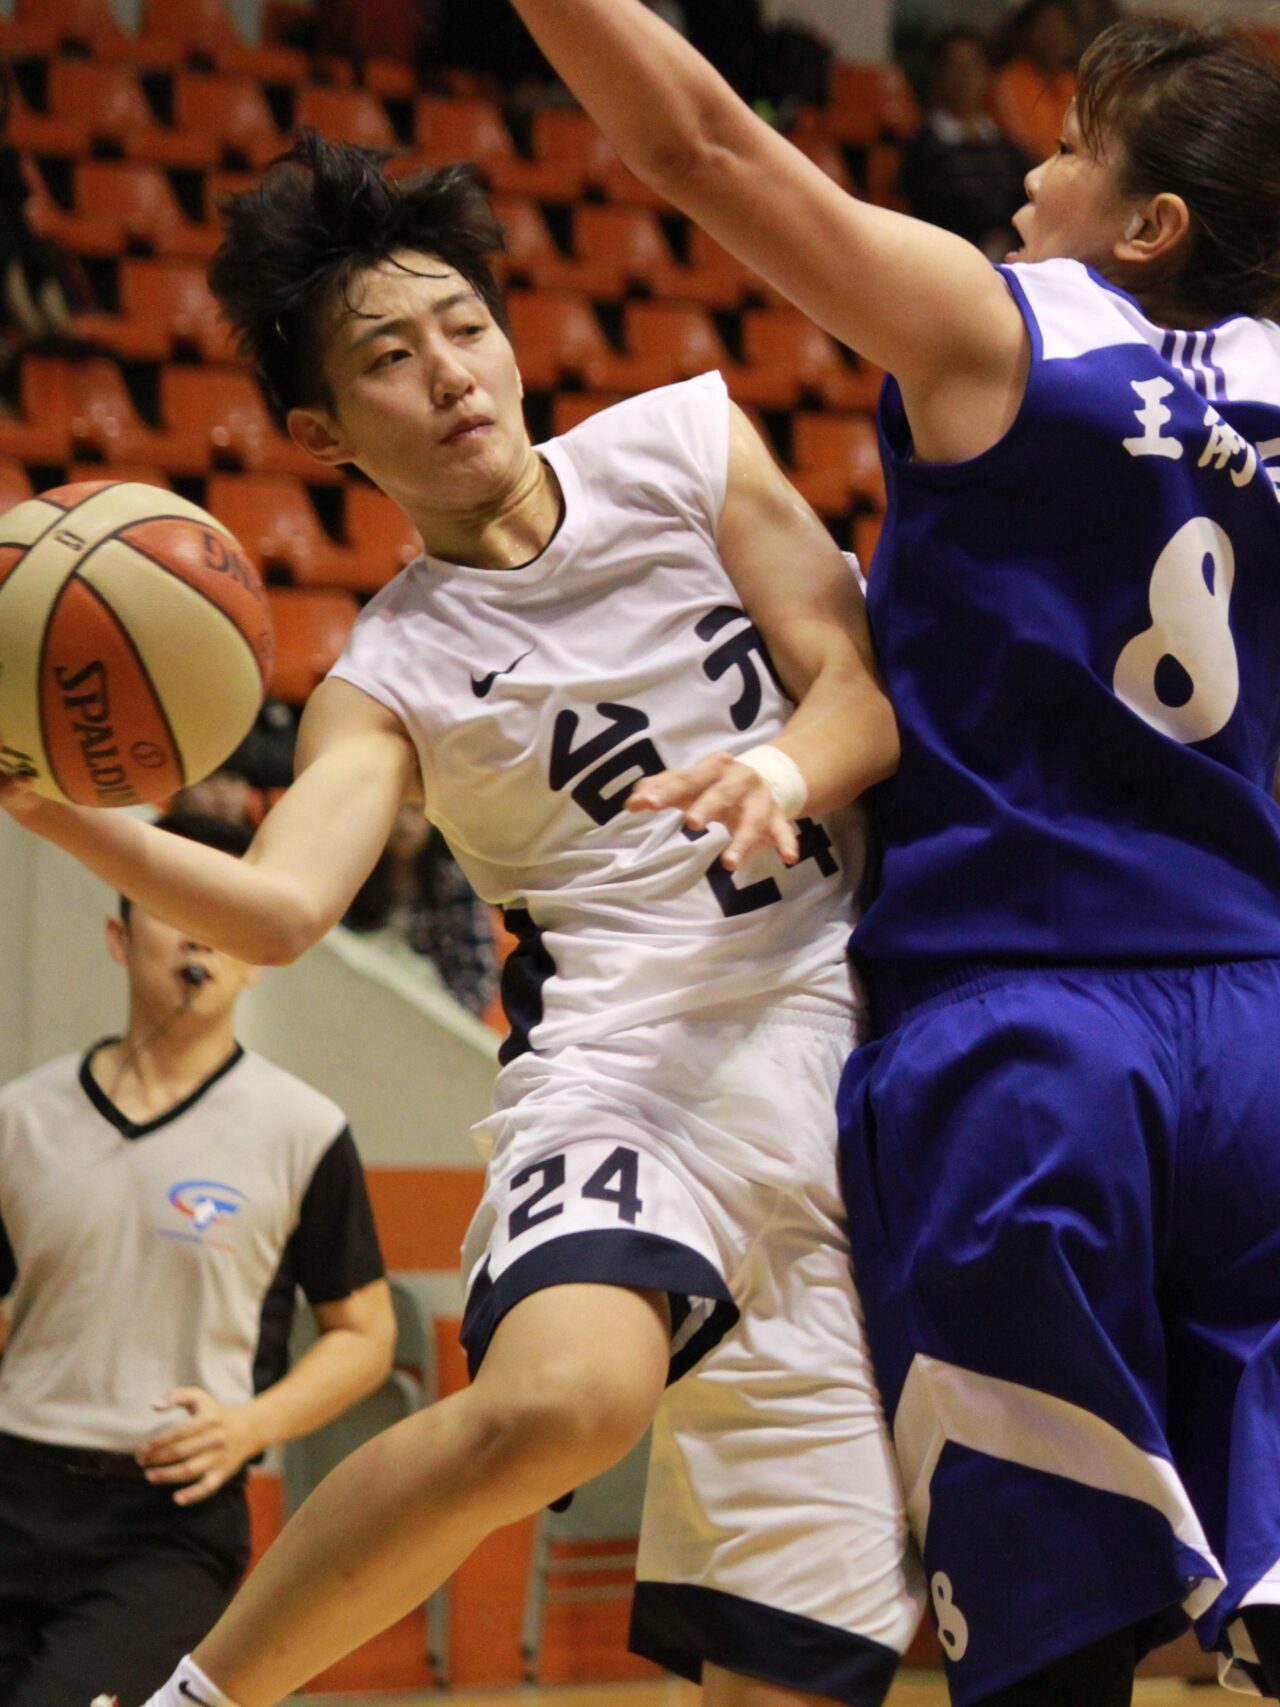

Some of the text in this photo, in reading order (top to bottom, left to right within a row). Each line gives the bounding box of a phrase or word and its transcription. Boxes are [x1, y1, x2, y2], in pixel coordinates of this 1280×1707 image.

[1113, 516, 1240, 744] 8
[54, 660, 136, 799] SPALDI
[508, 1145, 643, 1243] 24
[931, 1570, 969, 1662] 8
